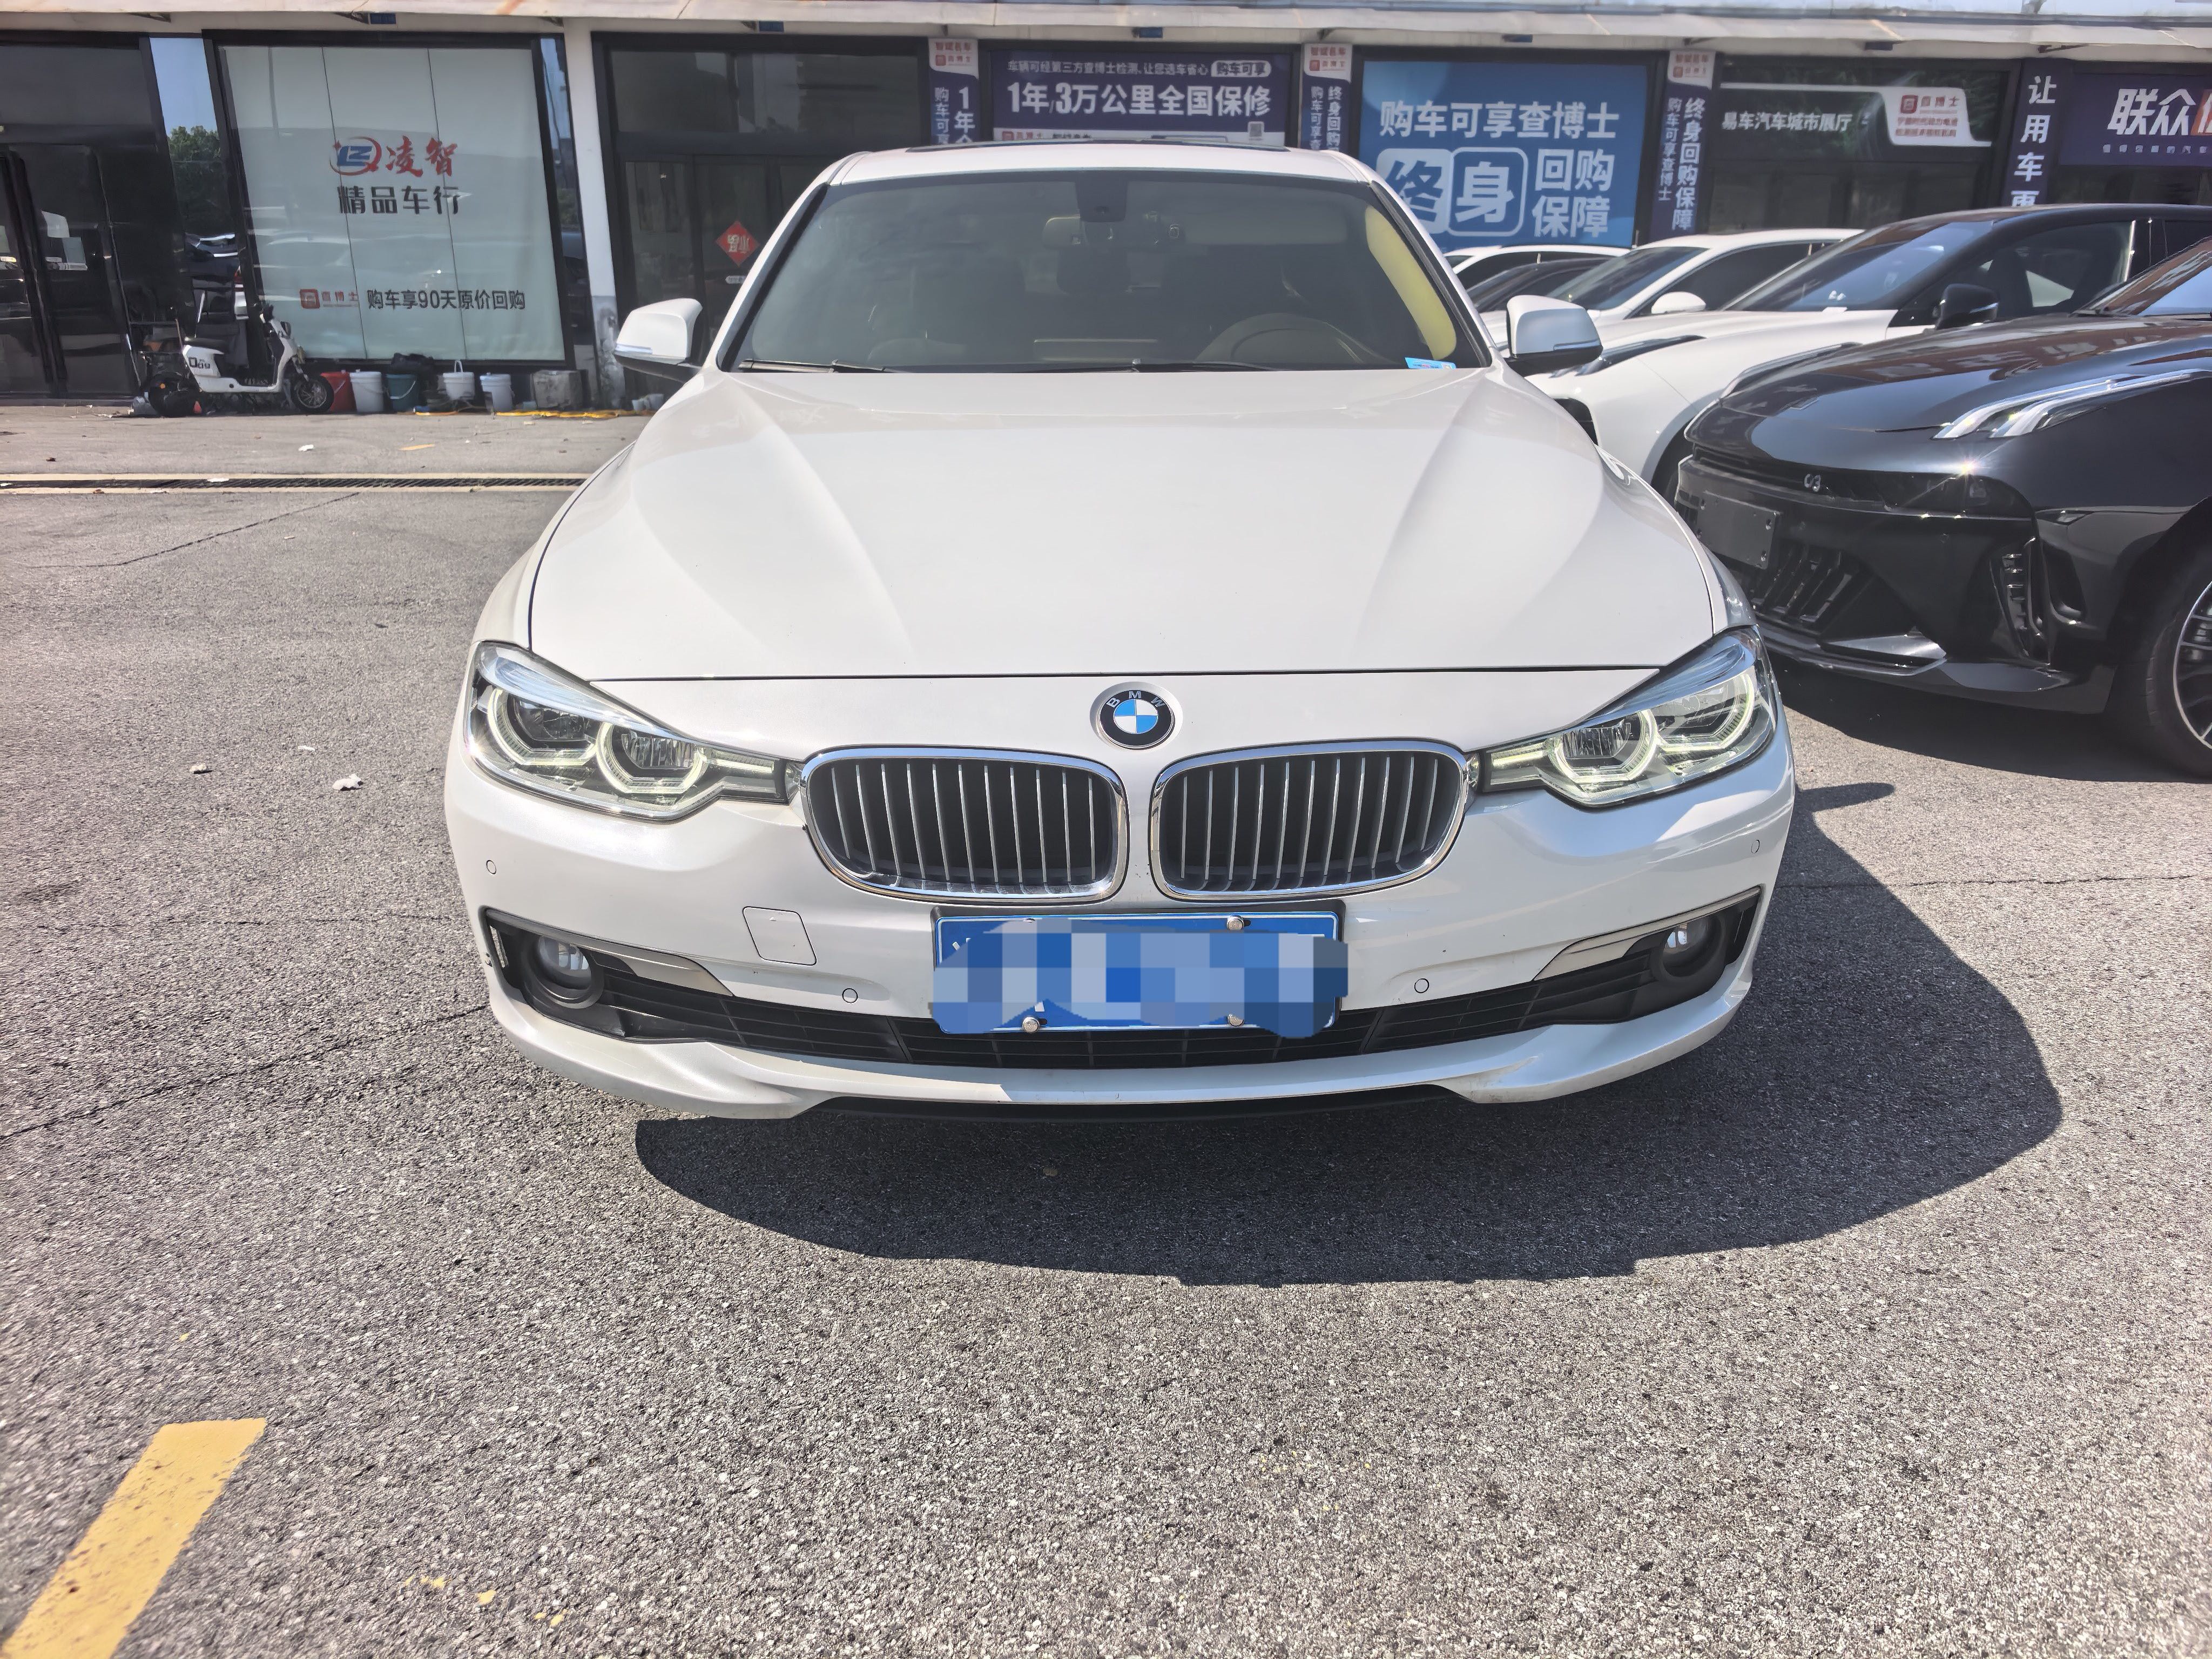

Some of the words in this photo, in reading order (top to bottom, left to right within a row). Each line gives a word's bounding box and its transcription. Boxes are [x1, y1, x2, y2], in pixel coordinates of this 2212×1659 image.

[1379, 100, 1620, 139] 购车可享查博士
[385, 135, 458, 177] 凌智
[1658, 97, 1683, 201] 购车可享查博士
[1671, 97, 1706, 231] 终身回购保障
[1385, 160, 1514, 223] 终身
[1535, 149, 1615, 192] 回购
[336, 185, 459, 214] 精品车行
[1532, 195, 1610, 238] 保障
[367, 289, 525, 309] 购车享90天原价回购
[1106, 691, 1166, 709] BMW
